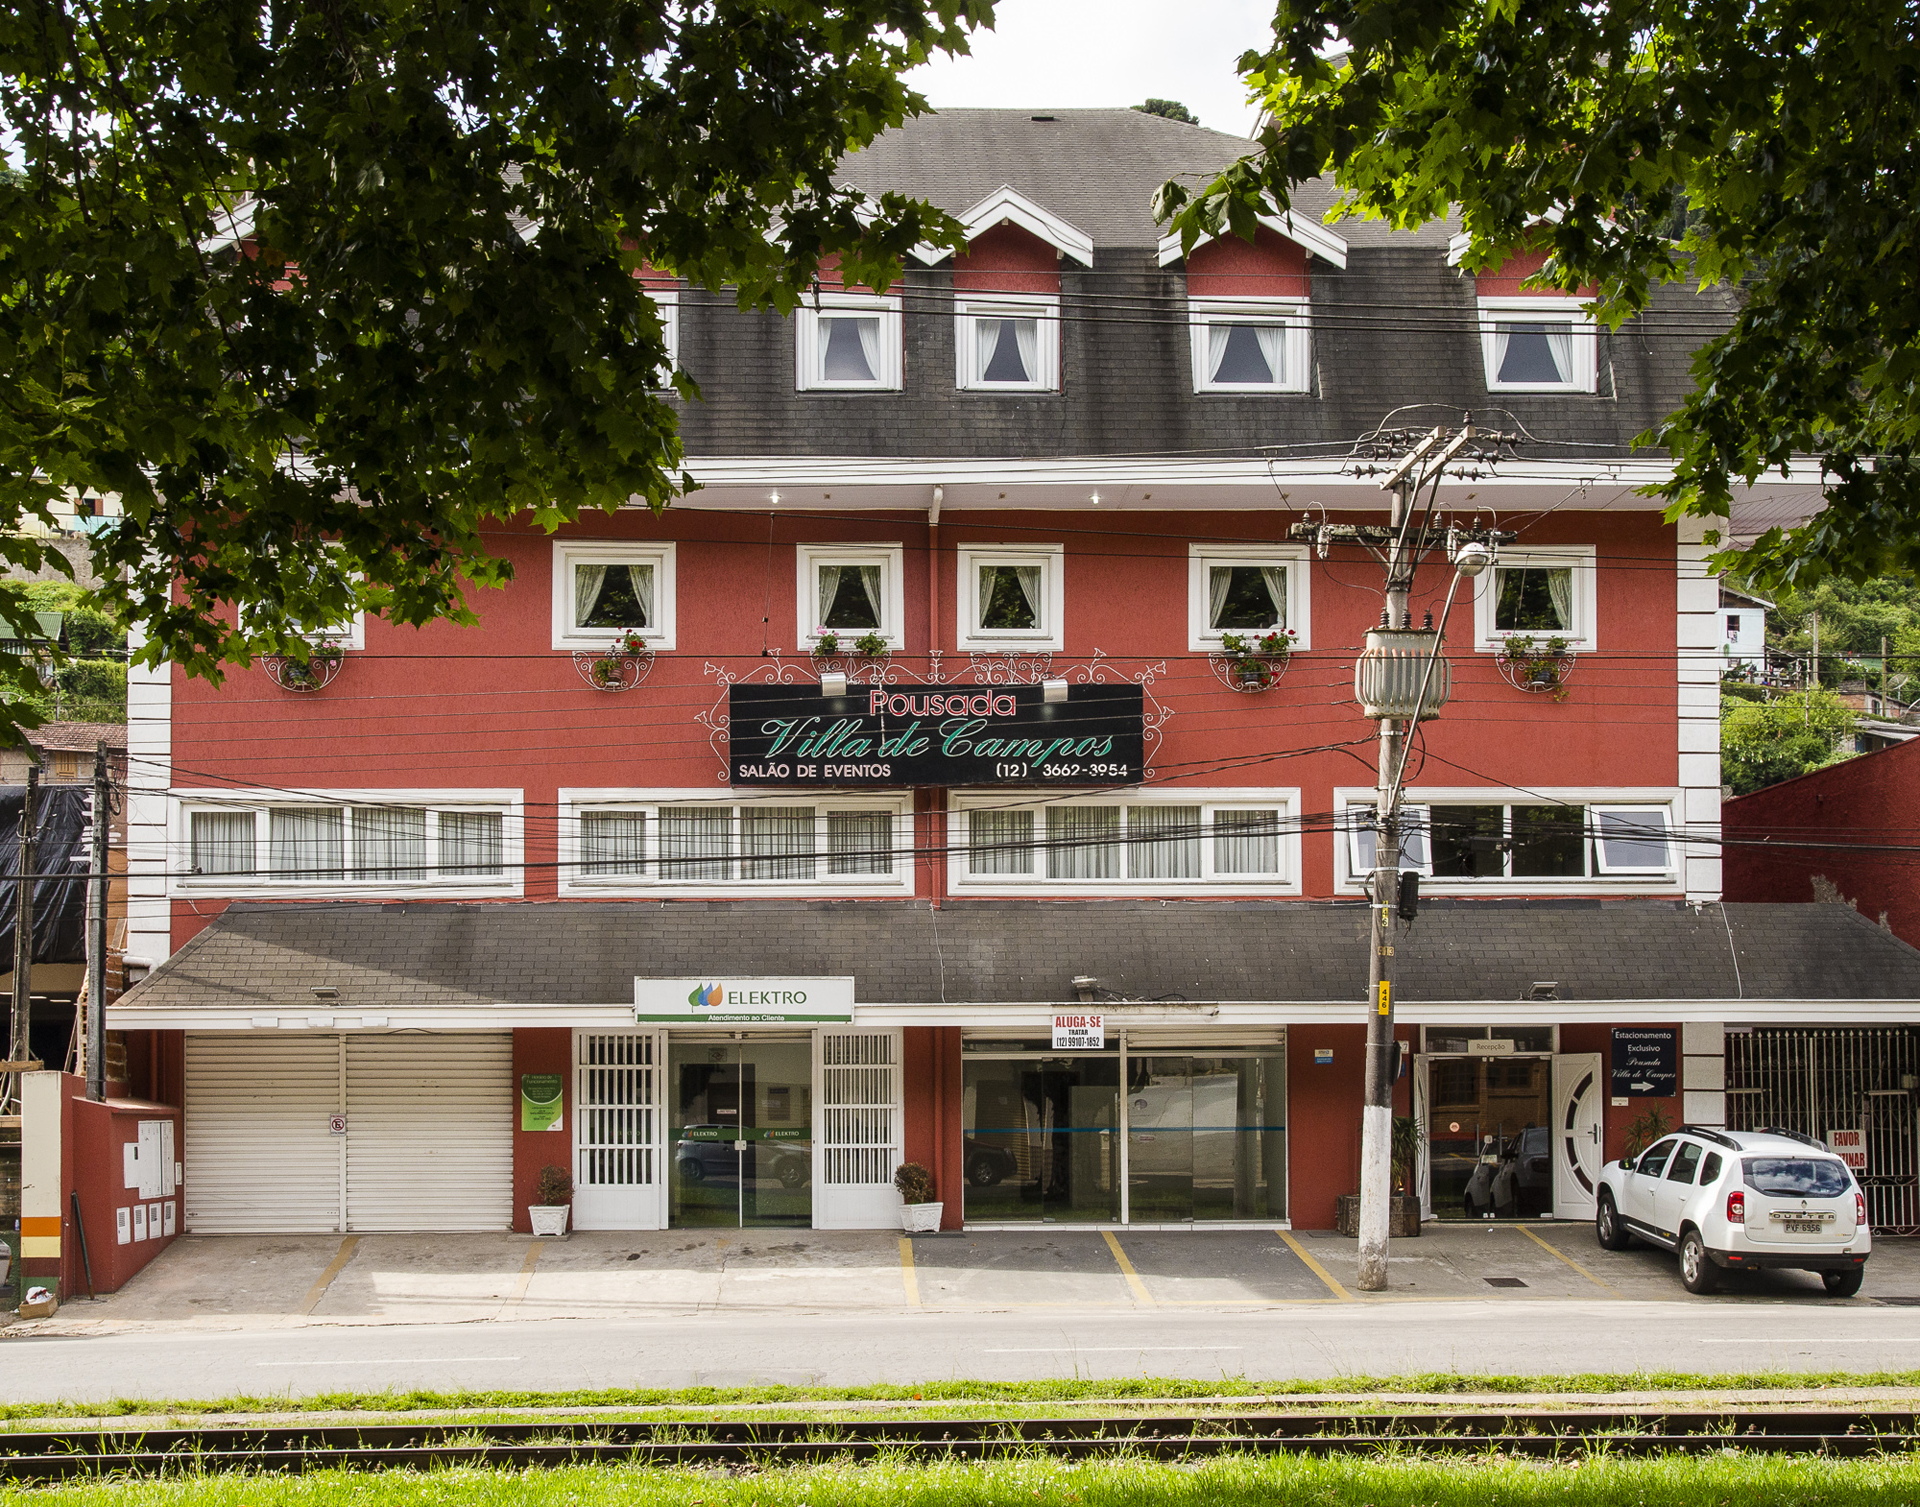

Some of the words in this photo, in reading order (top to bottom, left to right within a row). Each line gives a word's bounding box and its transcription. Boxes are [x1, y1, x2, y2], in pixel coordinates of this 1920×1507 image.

[870, 690, 1016, 716] Pousada
[761, 717, 872, 758] Villa
[878, 721, 929, 758] de
[939, 718, 1113, 767] Campos
[739, 762, 790, 778] SALÃO
[797, 765, 817, 778] DE
[824, 764, 891, 778] EVENTOS
[996, 762, 1027, 777] (12)
[1042, 764, 1128, 777] 3662-3954
[728, 991, 807, 1005] ELEKTRO
[1055, 1016, 1101, 1027] ALUGA-SE
[1615, 1031, 1672, 1039] Estacionamento
[1476, 1043, 1506, 1052] Recepção
[1627, 1044, 1661, 1052] Exclusivo
[1626, 1057, 1661, 1066] Pousada
[1611, 1069, 1631, 1078] Villa
[1632, 1070, 1642, 1078] de
[1645, 1069, 1676, 1081] Campos
[1834, 1132, 1860, 1146] FAVOR
